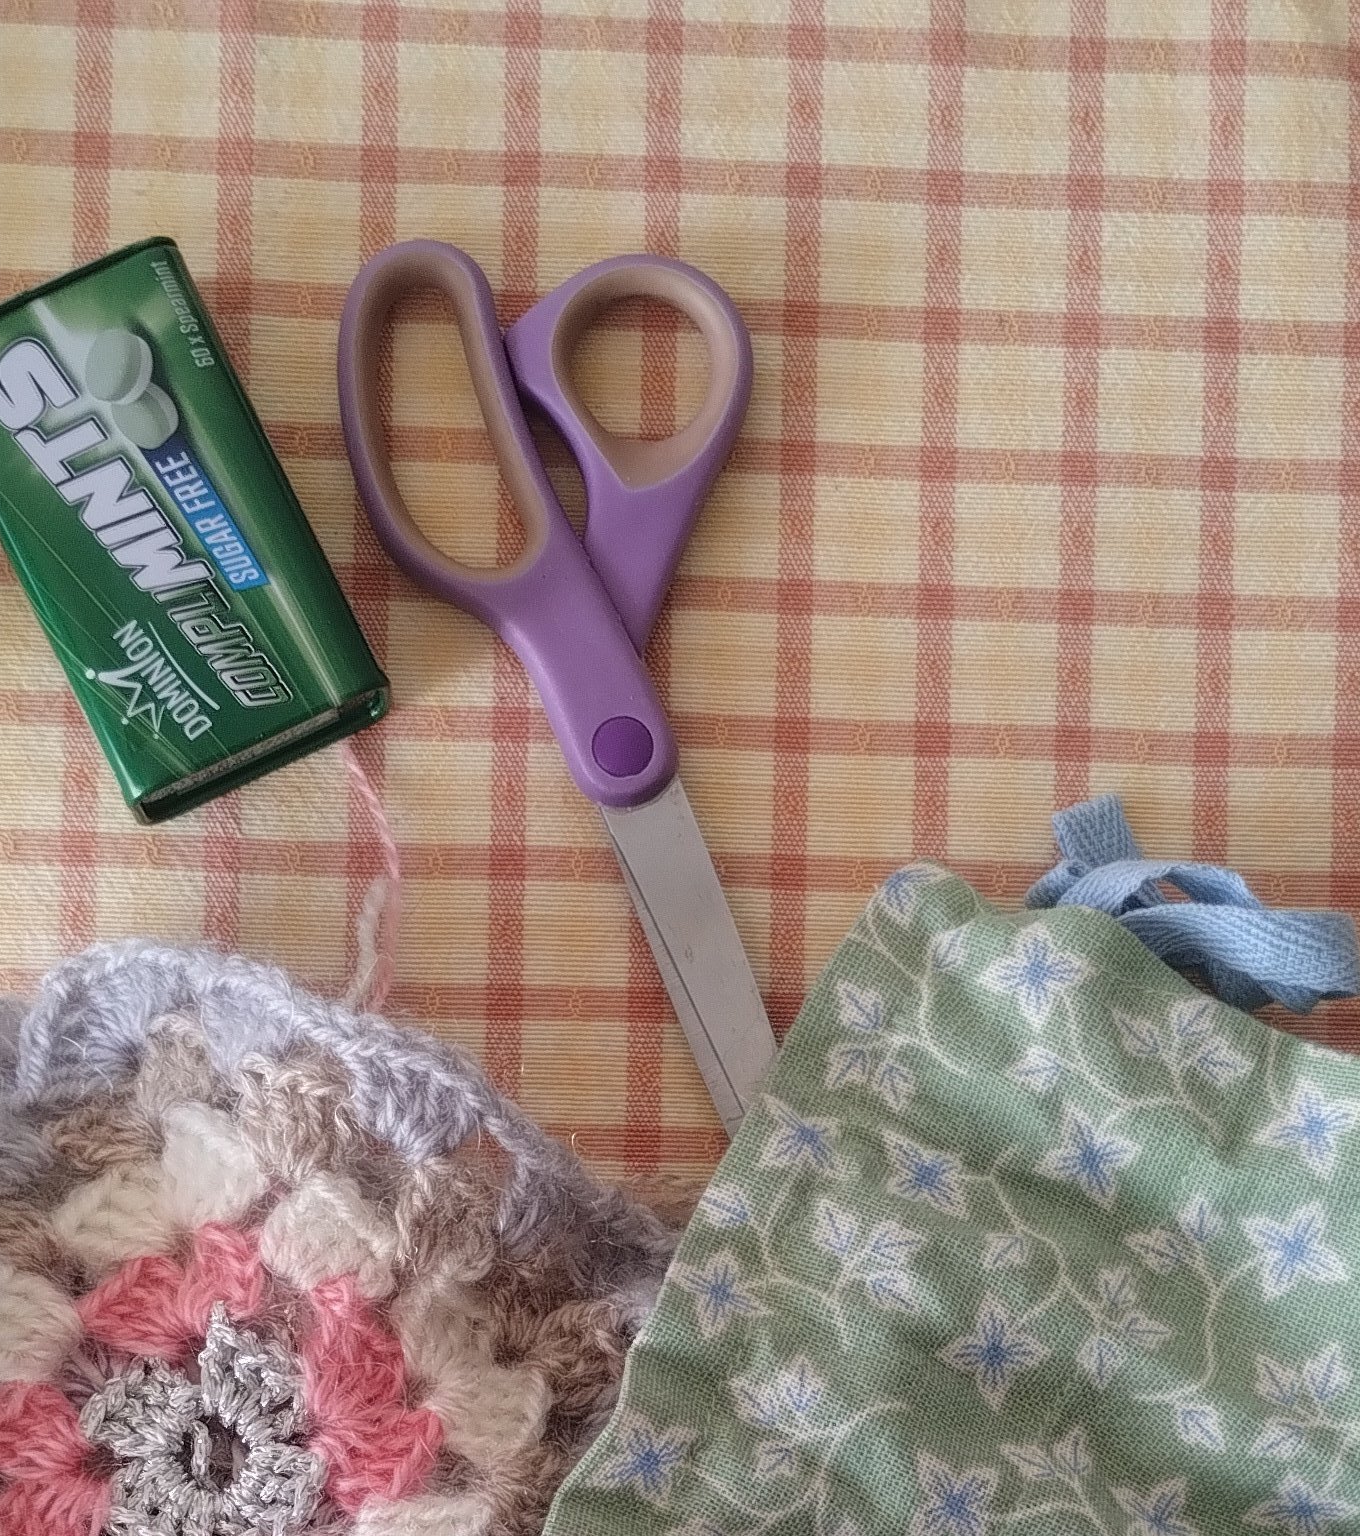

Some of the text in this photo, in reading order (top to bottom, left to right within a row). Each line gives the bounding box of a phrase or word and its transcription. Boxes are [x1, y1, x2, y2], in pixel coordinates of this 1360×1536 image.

[149, 260, 215, 368] 60 x Spearmint
[154, 450, 260, 585] SUGAR FREE
[112, 619, 213, 741] DOMINION
